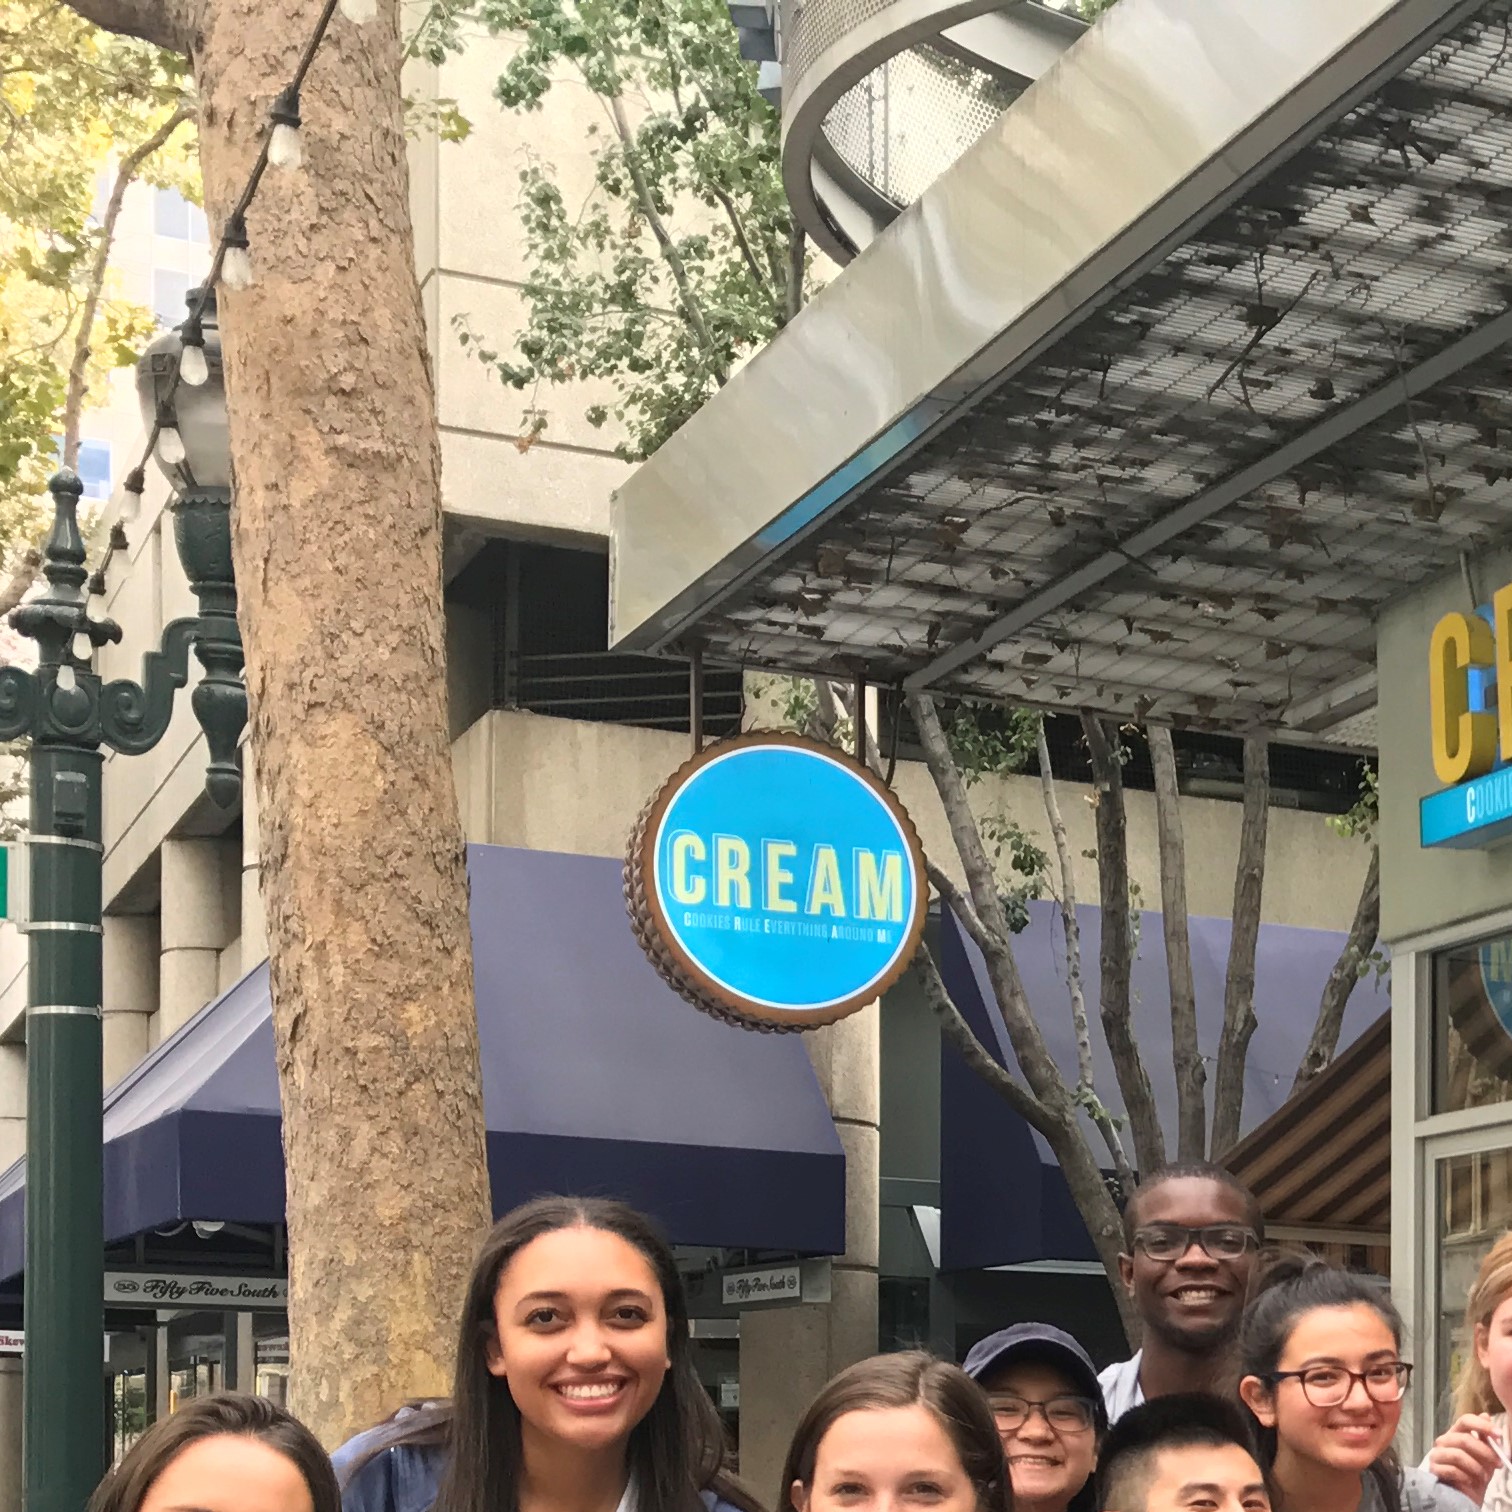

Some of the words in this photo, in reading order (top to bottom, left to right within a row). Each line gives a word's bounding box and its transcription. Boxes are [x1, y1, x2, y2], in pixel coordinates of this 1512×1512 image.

[667, 828, 903, 923] CREAM
[684, 911, 731, 930] COOKIES
[733, 916, 761, 934] RULE
